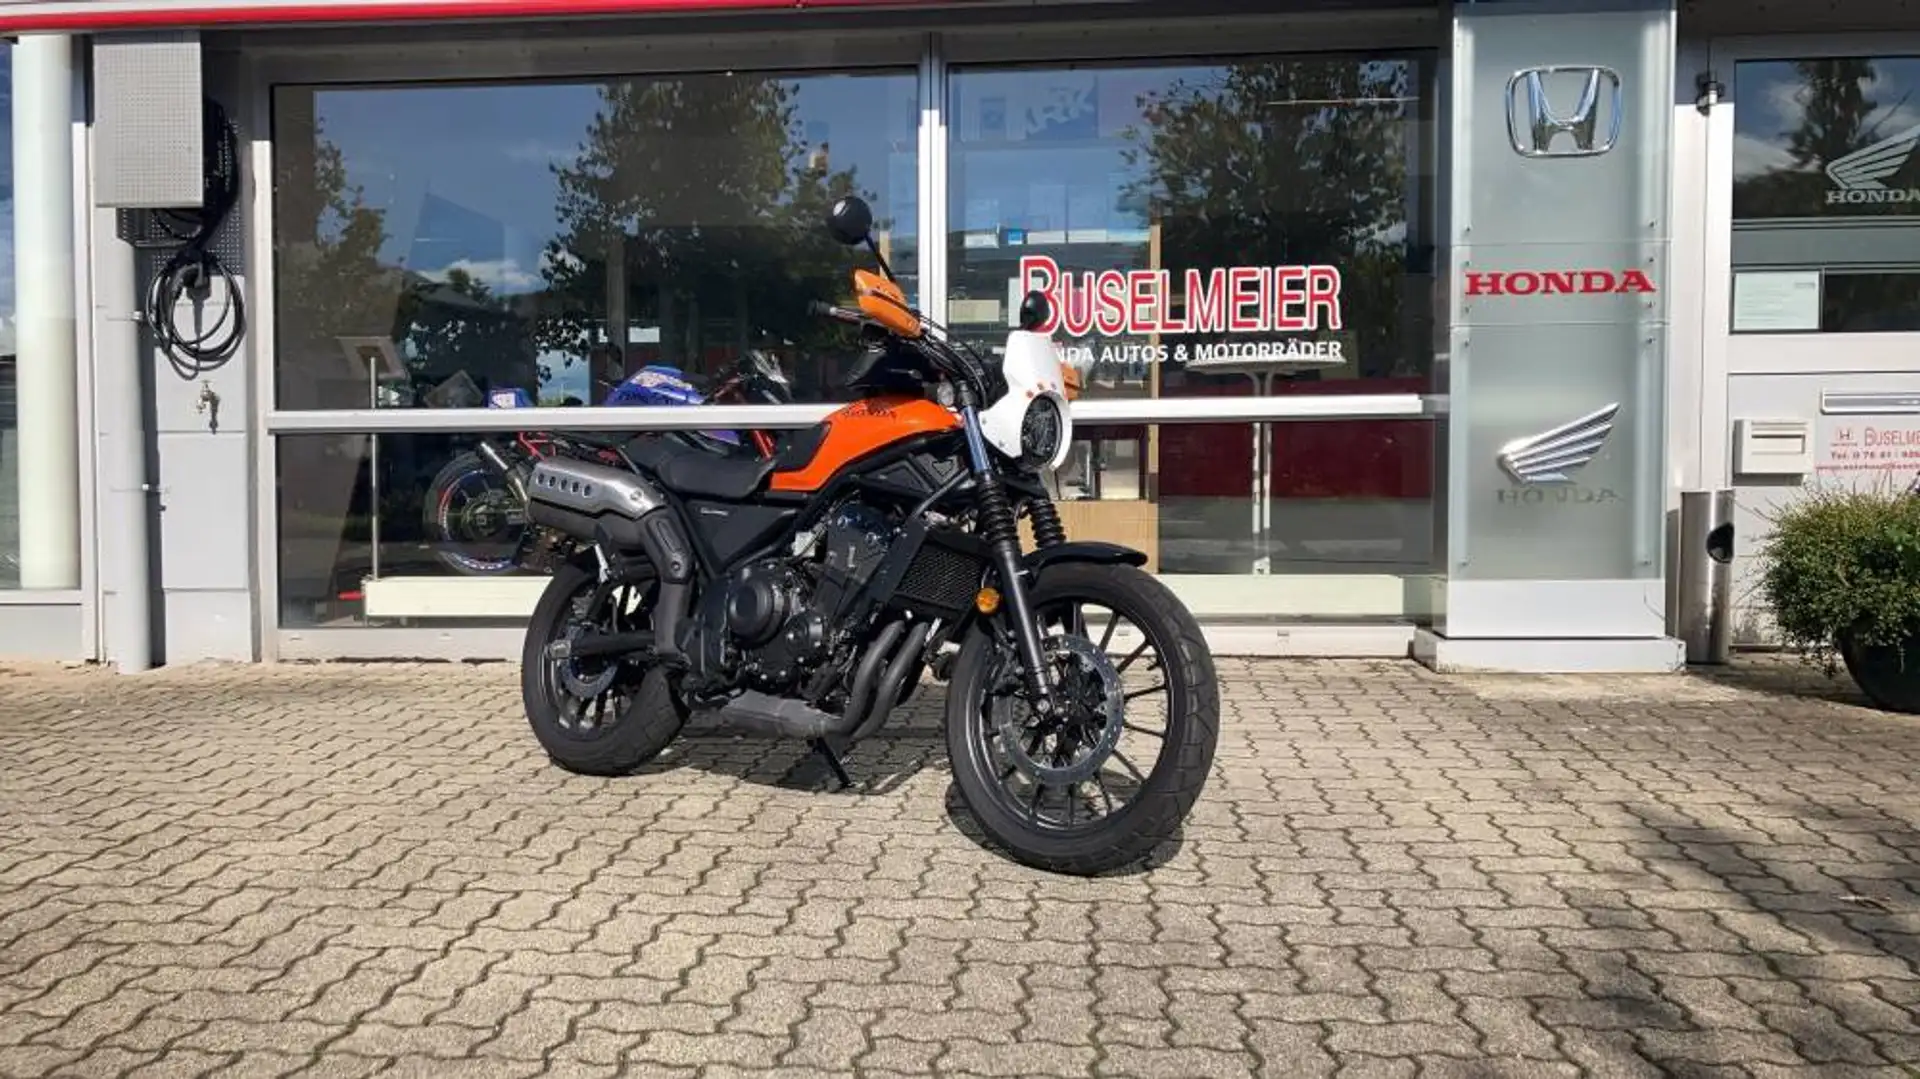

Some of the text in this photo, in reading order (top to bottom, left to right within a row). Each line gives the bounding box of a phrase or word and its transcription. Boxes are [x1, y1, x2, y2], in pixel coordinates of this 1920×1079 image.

[1825, 188, 1920, 205] HONDA
[1019, 255, 1342, 337] BUSELMEIER
[1465, 270, 1656, 296] HONDA
[1054, 338, 1342, 364] NDA AUTOS & MOTORRÄDER
